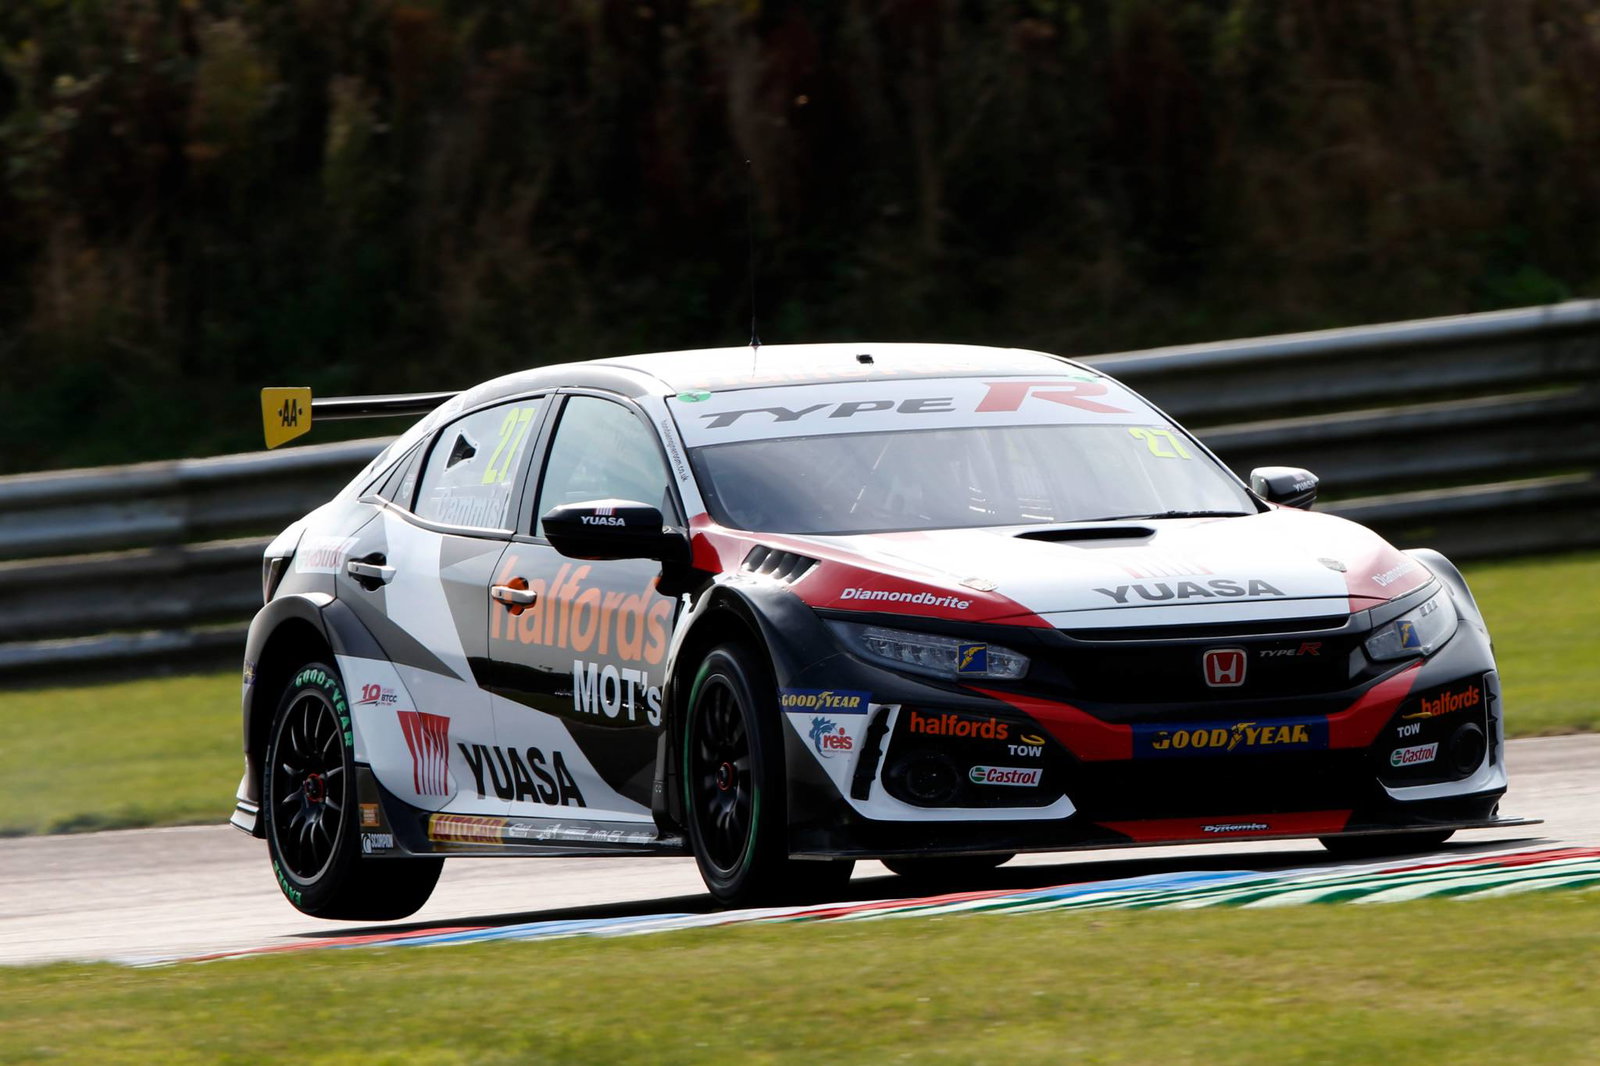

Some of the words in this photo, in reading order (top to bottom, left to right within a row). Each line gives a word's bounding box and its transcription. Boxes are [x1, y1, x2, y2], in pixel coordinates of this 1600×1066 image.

[280, 398, 298, 428] AA
[700, 396, 957, 430] TYPE
[974, 381, 1135, 413] R
[482, 407, 536, 484] 27
[1127, 426, 1193, 461] 27
[580, 516, 626, 528] YUASA
[840, 587, 970, 610] Diamondbrite
[1092, 578, 1287, 604] YUASA
[490, 554, 673, 665] halfords
[1259, 649, 1296, 657] TYPE
[1297, 642, 1323, 656] R
[381, 694, 398, 703] BTCC
[573, 659, 662, 727] MOT's
[1421, 684, 1480, 717] halfords
[823, 727, 853, 750] reis
[909, 711, 1009, 740] halfords
[1396, 722, 1421, 738] TOW
[1008, 744, 1043, 757] TOW
[1402, 747, 1435, 764] Castrol
[457, 743, 587, 808] YUASA
[985, 767, 1038, 785] Castrol
